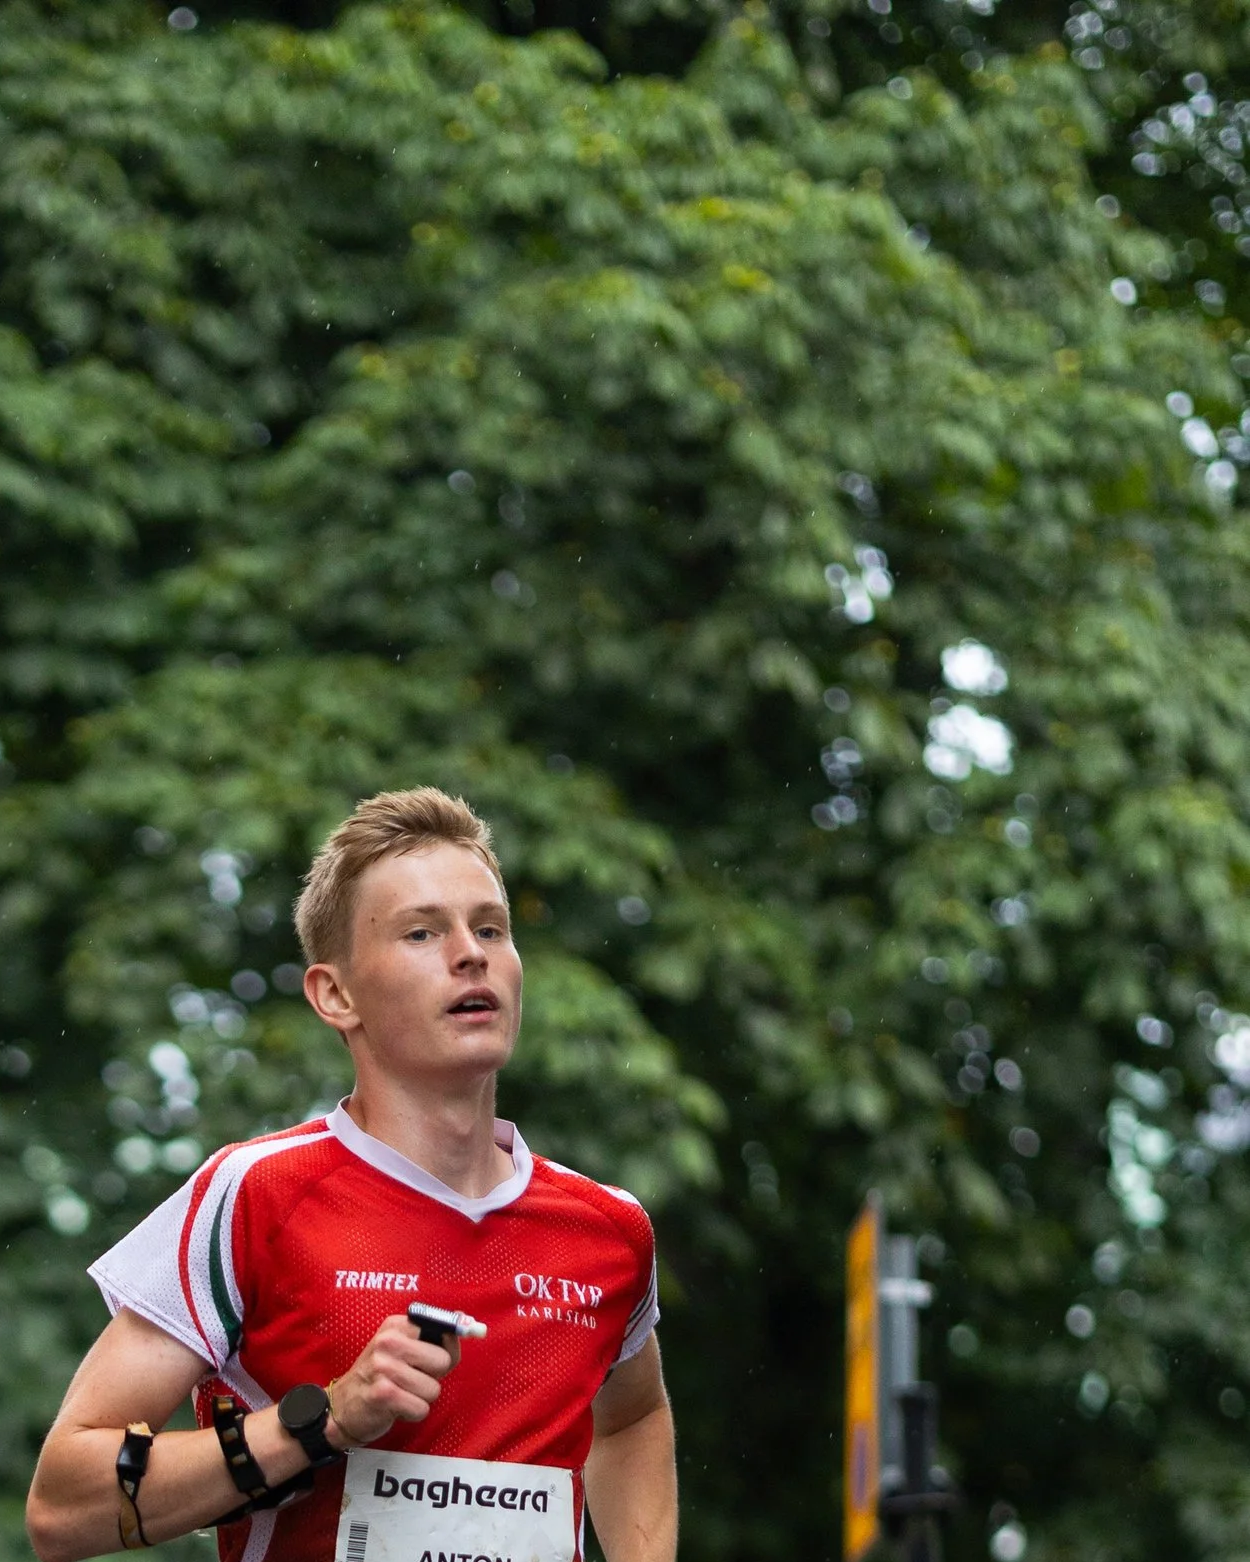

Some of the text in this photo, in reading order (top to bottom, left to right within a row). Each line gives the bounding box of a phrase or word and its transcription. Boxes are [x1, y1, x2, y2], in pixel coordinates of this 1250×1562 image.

[335, 1270, 419, 1291] TRIMTEX
[514, 1273, 603, 1308] OK TYR
[517, 1304, 596, 1329] KARLSTAD
[373, 1468, 549, 1513] bagheera
